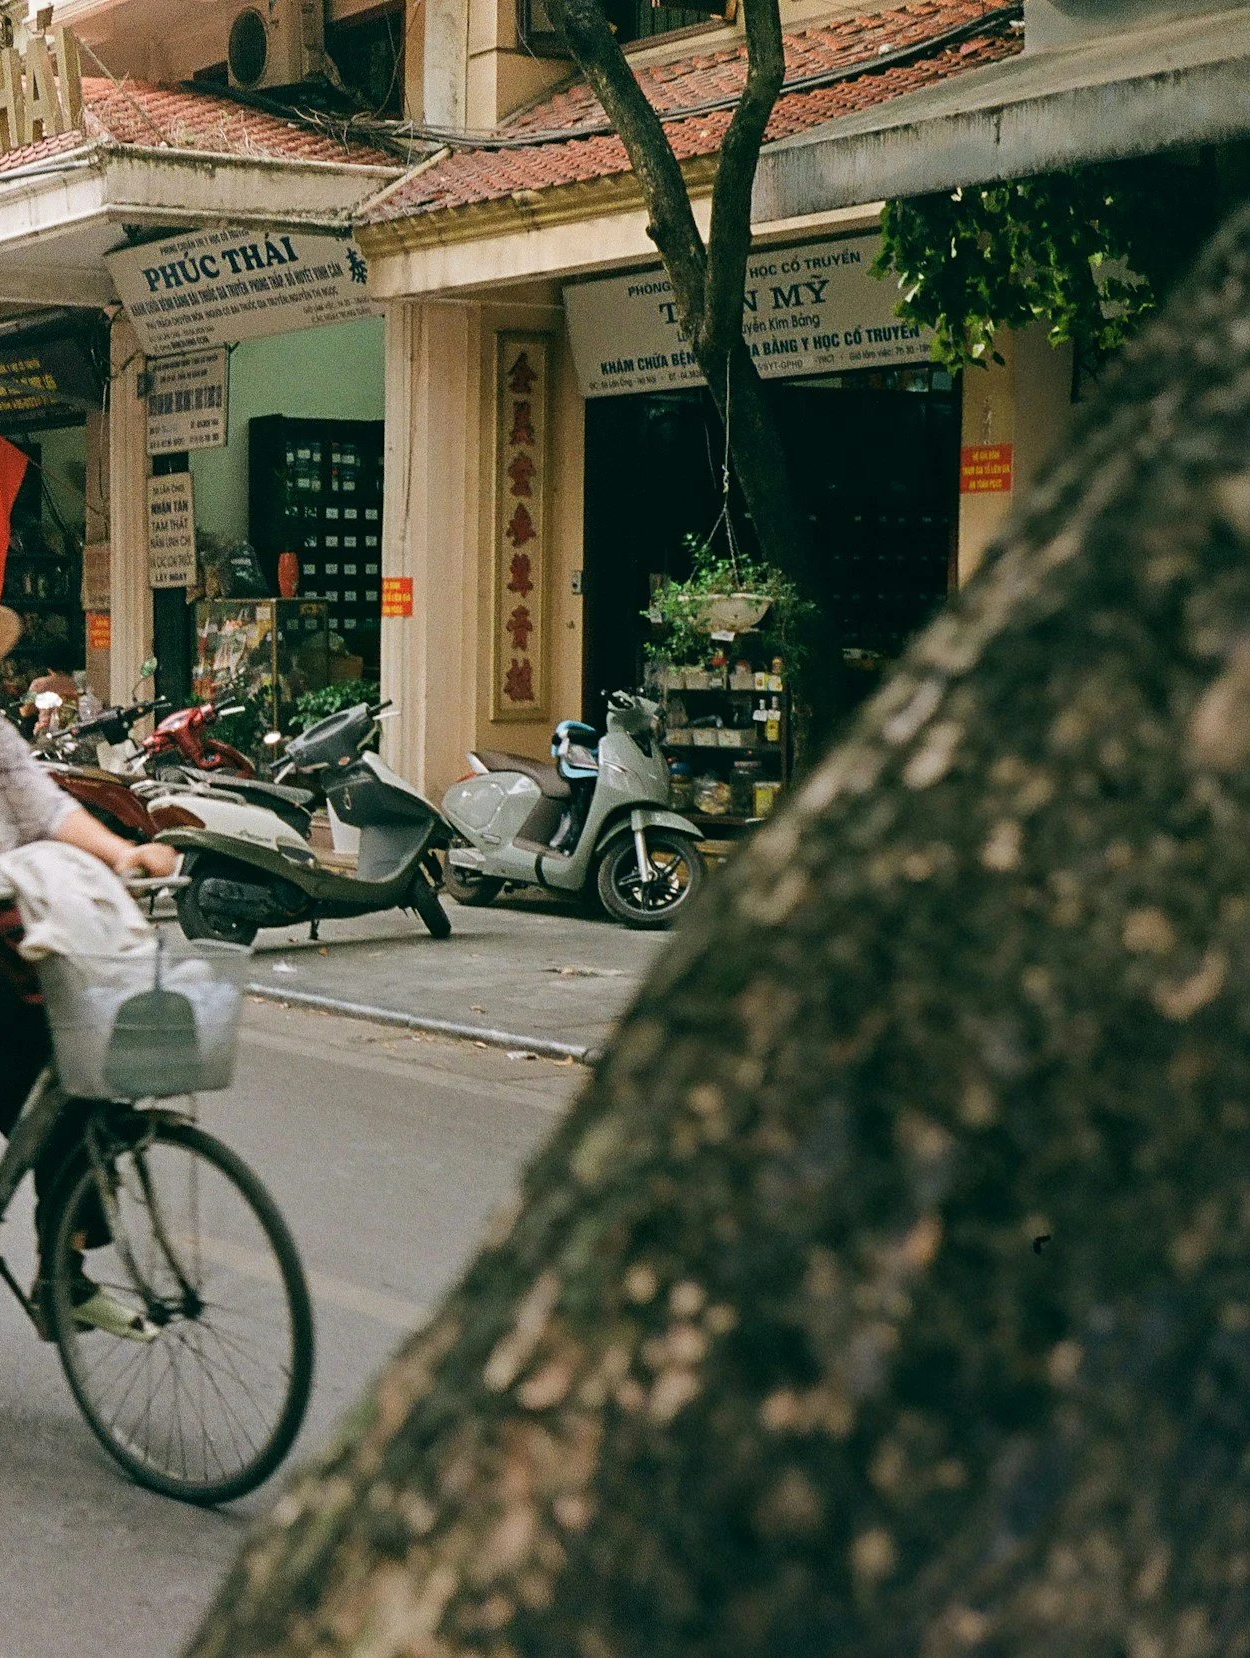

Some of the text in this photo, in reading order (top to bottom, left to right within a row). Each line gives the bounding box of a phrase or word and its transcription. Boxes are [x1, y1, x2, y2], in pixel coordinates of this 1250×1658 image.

[142, 232, 298, 292] PHÚC THÁI
[750, 263, 778, 279] HỌC
[769, 274, 830, 309] MỸ
[601, 357, 635, 376] KHÁM
[637, 353, 669, 371] CHỮA
[801, 337, 809, 351] Y
[813, 332, 840, 351] HỌC
[866, 322, 920, 343] TRUYỀN
